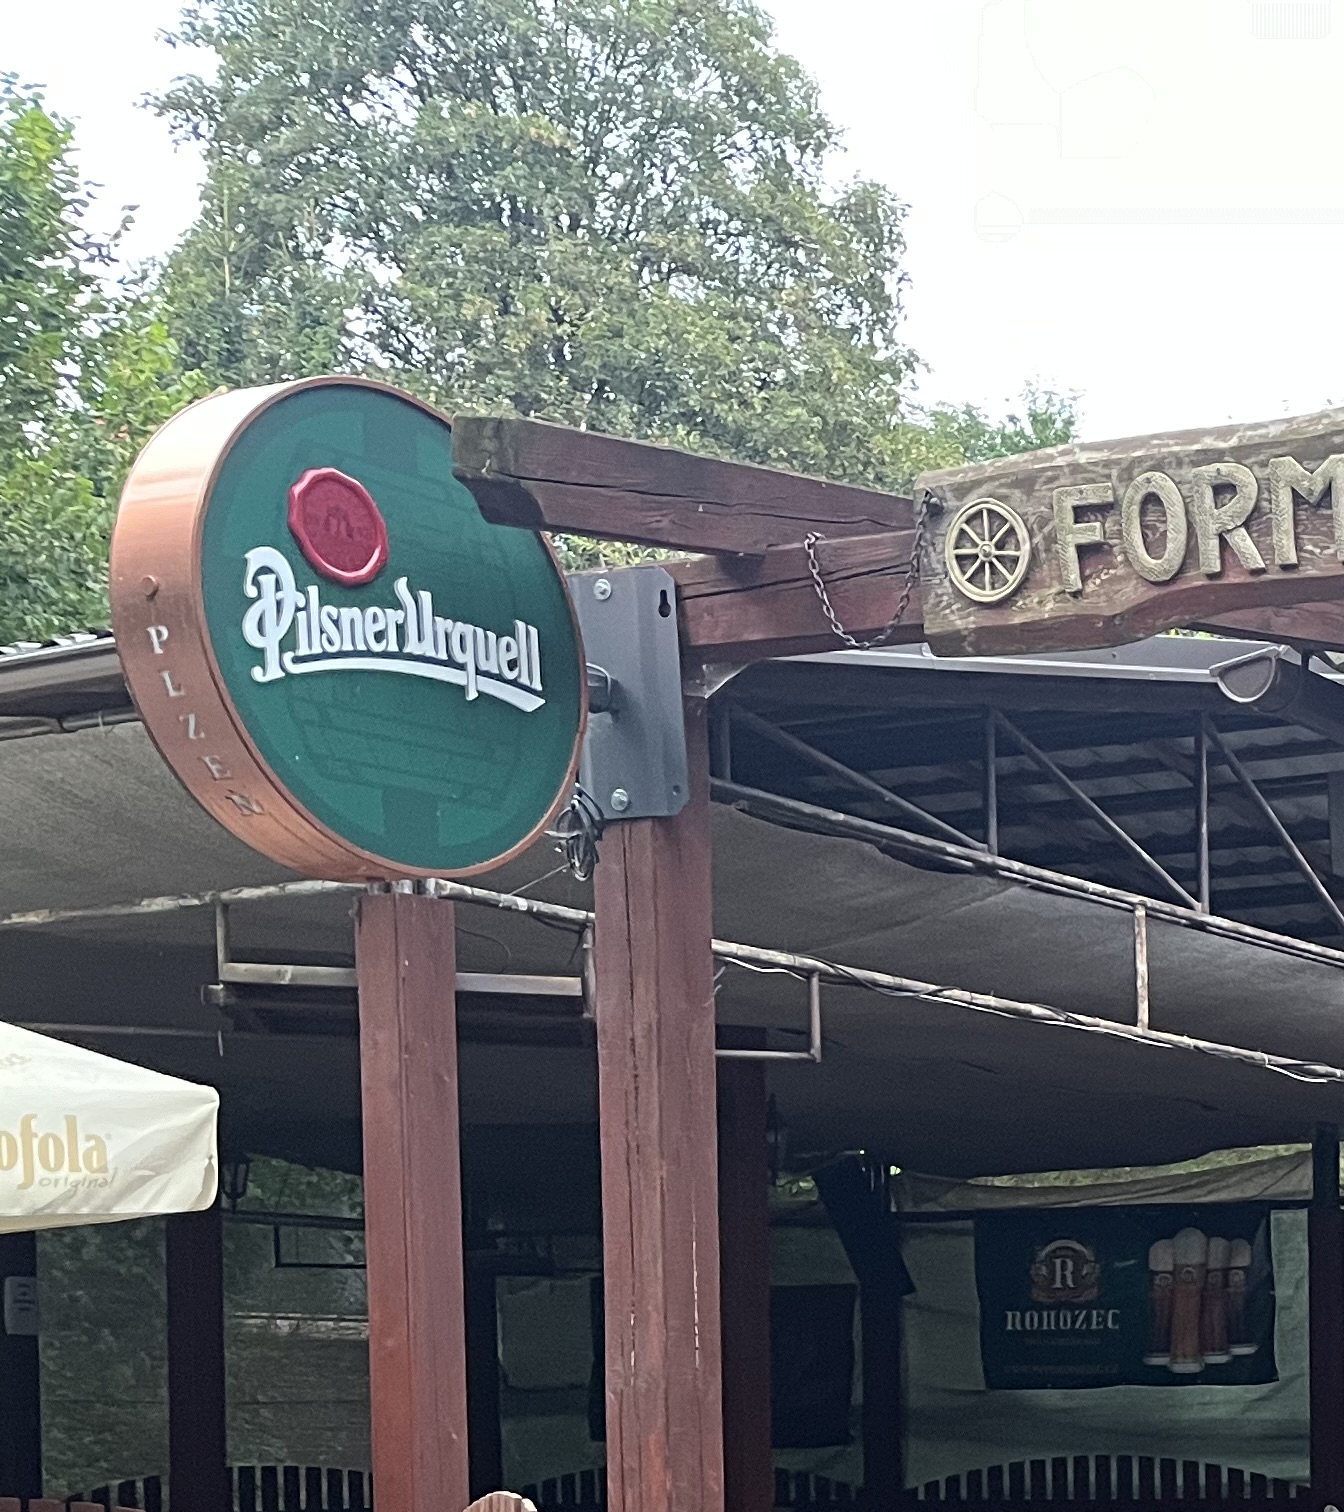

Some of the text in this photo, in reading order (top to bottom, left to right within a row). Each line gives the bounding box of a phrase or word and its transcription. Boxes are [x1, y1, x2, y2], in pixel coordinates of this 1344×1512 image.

[242, 545, 545, 703] Pilsner Urquell
[0, 1113, 108, 1190] ofola
[1005, 1308, 1121, 1331] ROHOZEC
